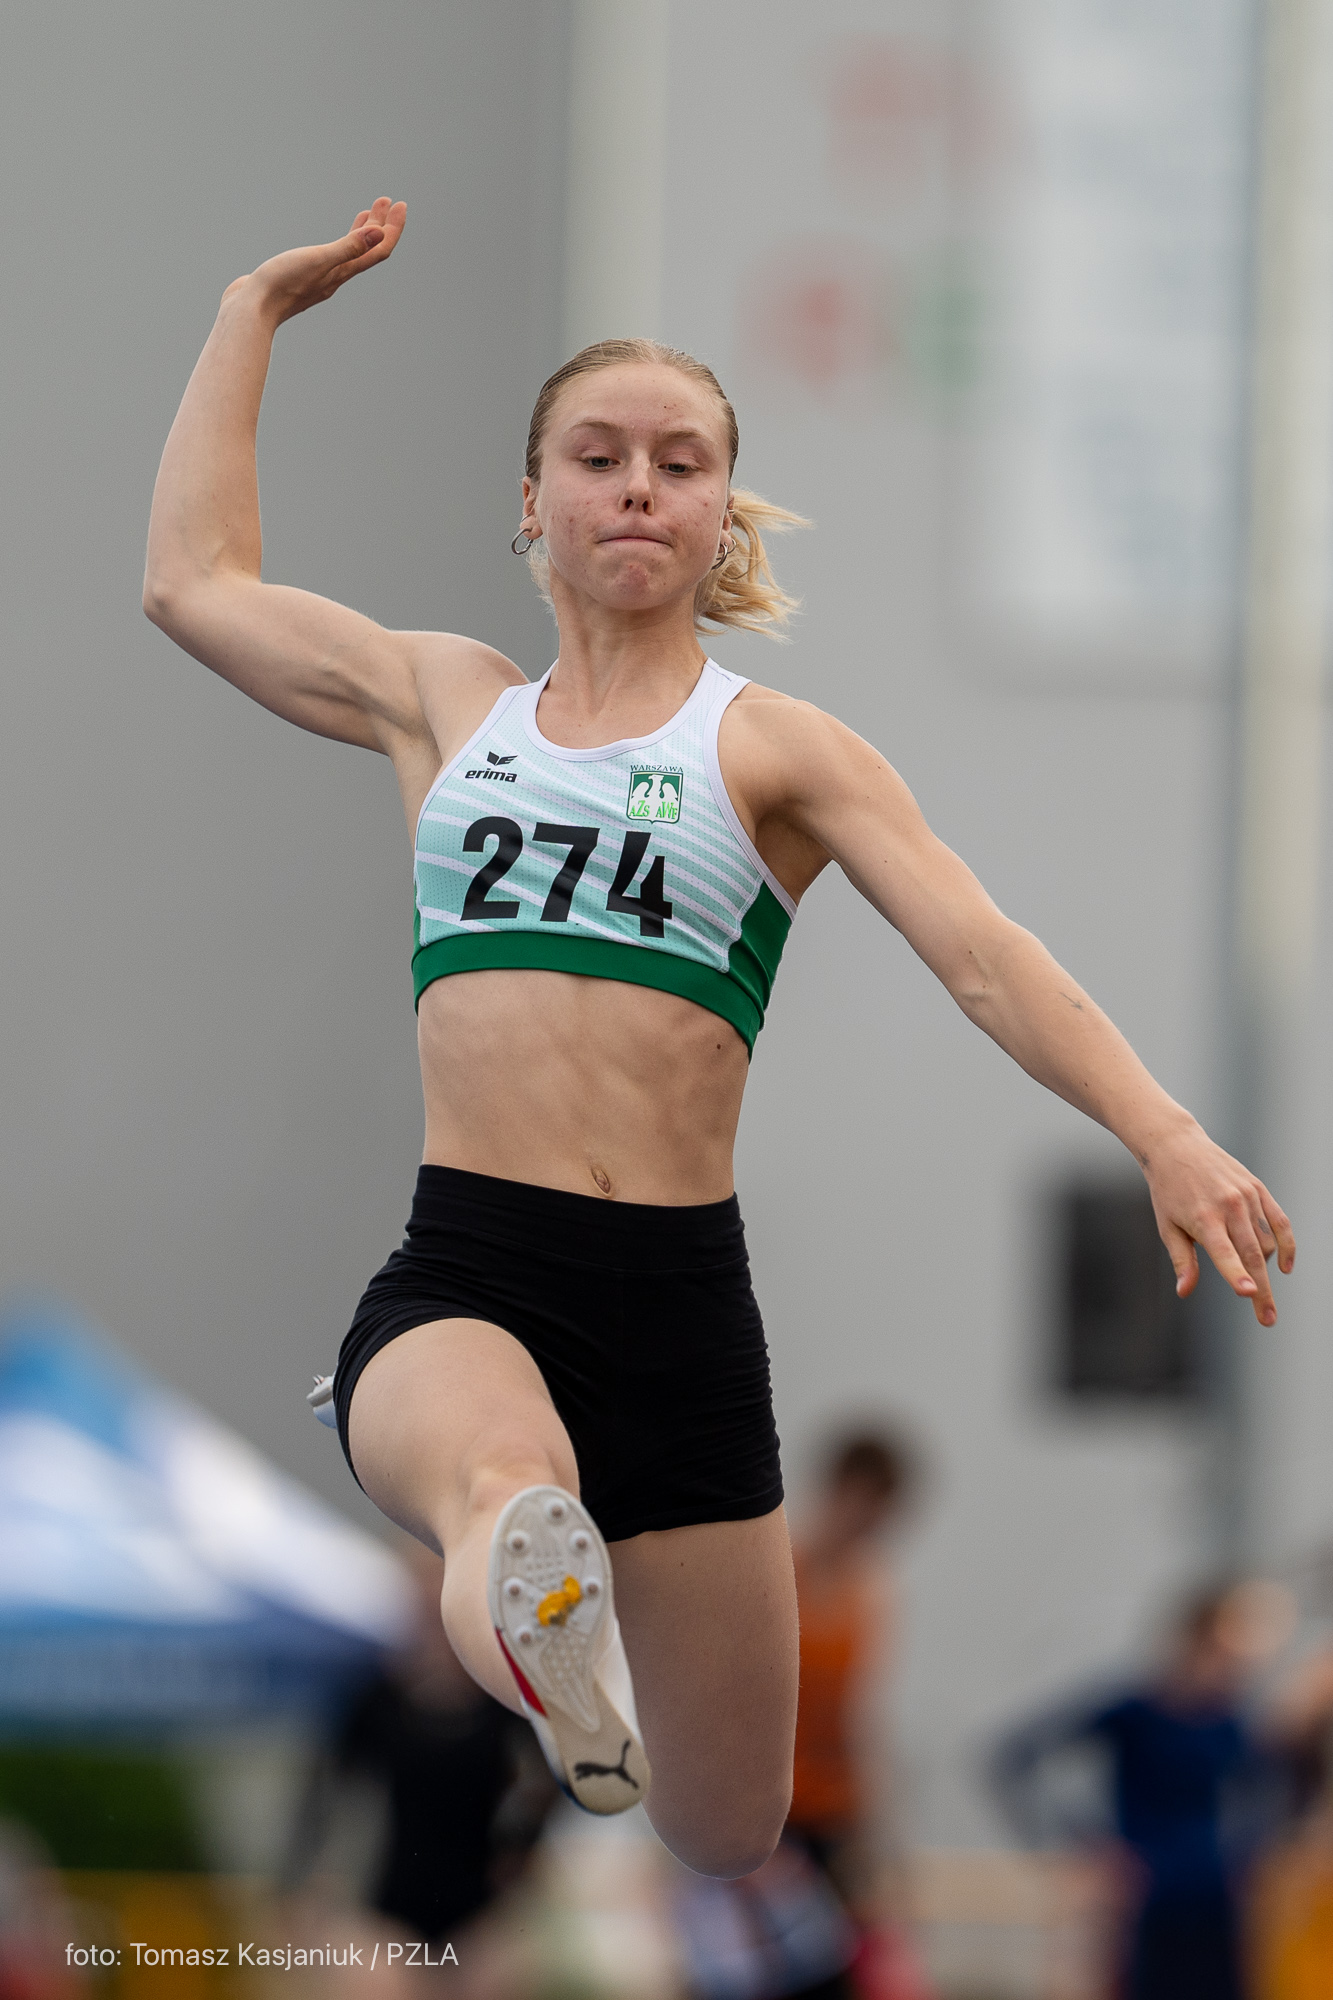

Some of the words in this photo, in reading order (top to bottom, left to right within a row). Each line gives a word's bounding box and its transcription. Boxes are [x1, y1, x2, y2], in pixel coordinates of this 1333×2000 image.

[464, 767, 518, 783] erima
[630, 764, 684, 773] WARSZAWA
[460, 815, 673, 939] 274
